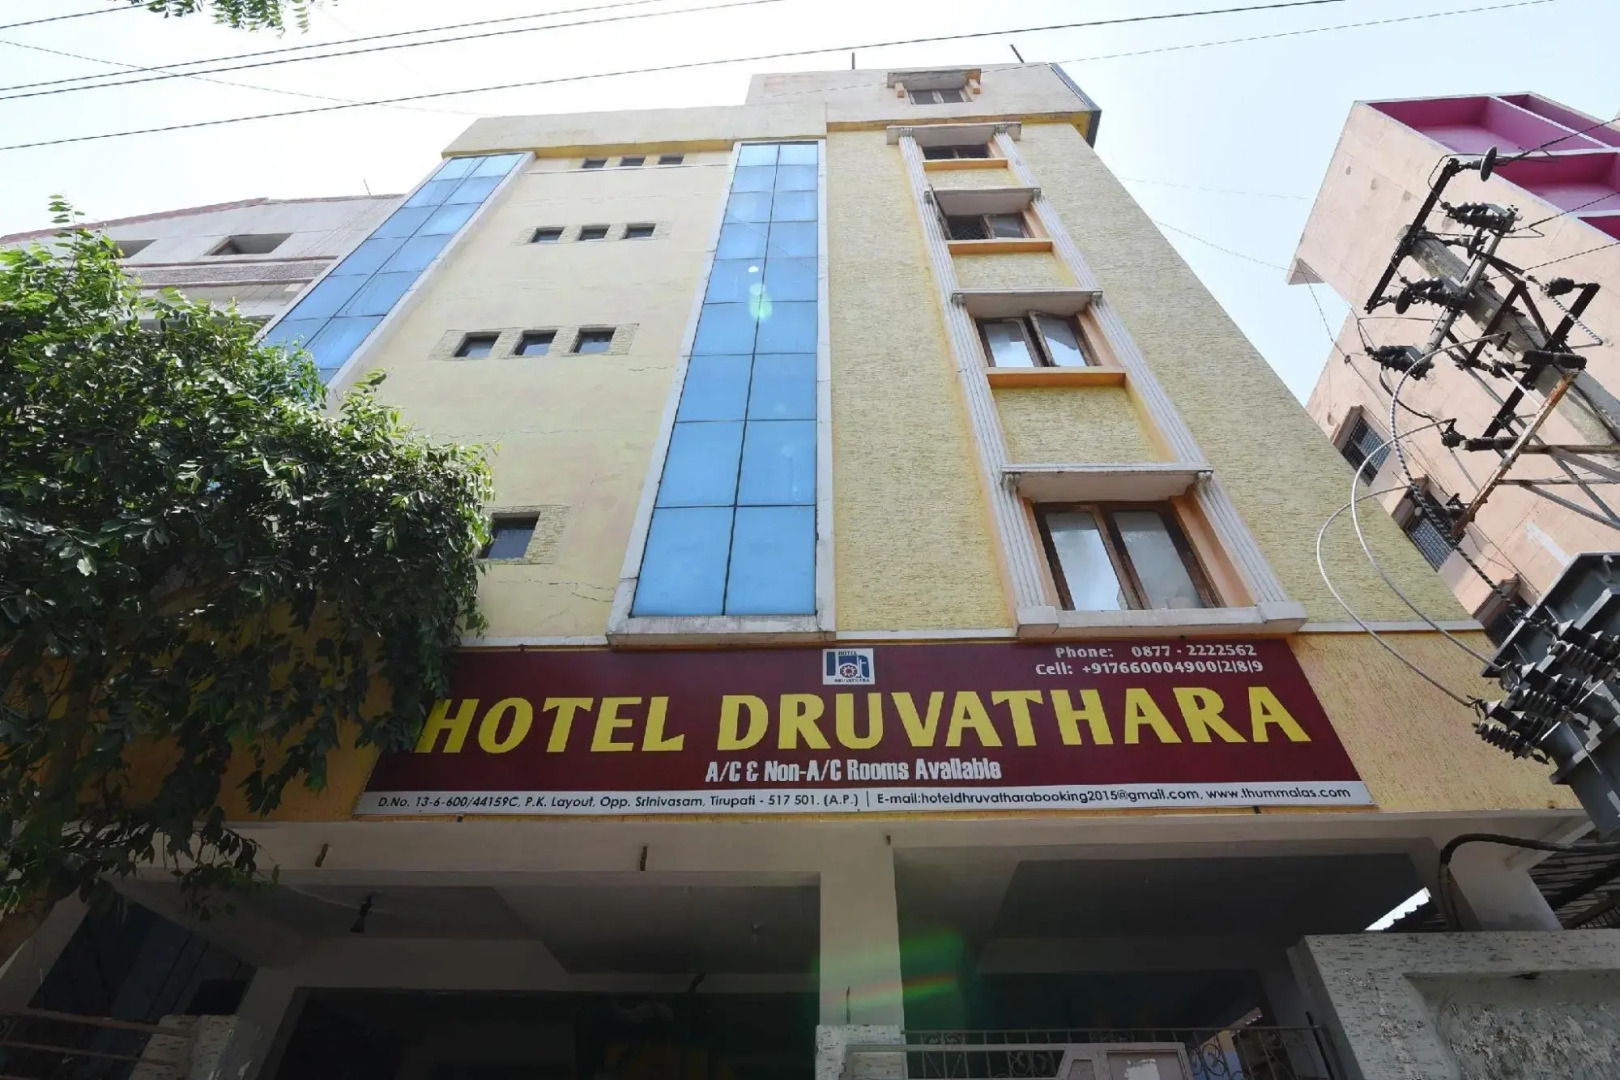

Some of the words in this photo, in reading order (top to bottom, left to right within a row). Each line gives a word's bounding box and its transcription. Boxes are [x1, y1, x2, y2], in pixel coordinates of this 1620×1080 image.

[1055, 646, 1114, 658] Phone:
[1131, 645, 1170, 658] 0877
[1186, 644, 1258, 656] 2222562
[1035, 661, 1073, 675] Cell:
[415, 696, 685, 753] HOTEL
[717, 685, 1312, 752] DRUVATHARA
[705, 761, 742, 783] A/C
[746, 760, 760, 782] &
[763, 759, 842, 782] Non-A/C
[846, 759, 910, 781] Rooms
[915, 757, 1003, 781] Available
[1205, 785, 1352, 800] www.thummalas.com
[378, 797, 410, 807] D.No.
[415, 796, 521, 808] 13-6-600/44159C,
[525, 796, 547, 807] P.K.
[551, 796, 596, 809] Layout,
[600, 796, 631, 810] Opp.
[635, 795, 706, 808] Srinivasam,
[710, 794, 756, 809] Tirupati
[768, 794, 790, 806] 517
[794, 794, 820, 805] 501.
[823, 793, 859, 807] (A.P.)
